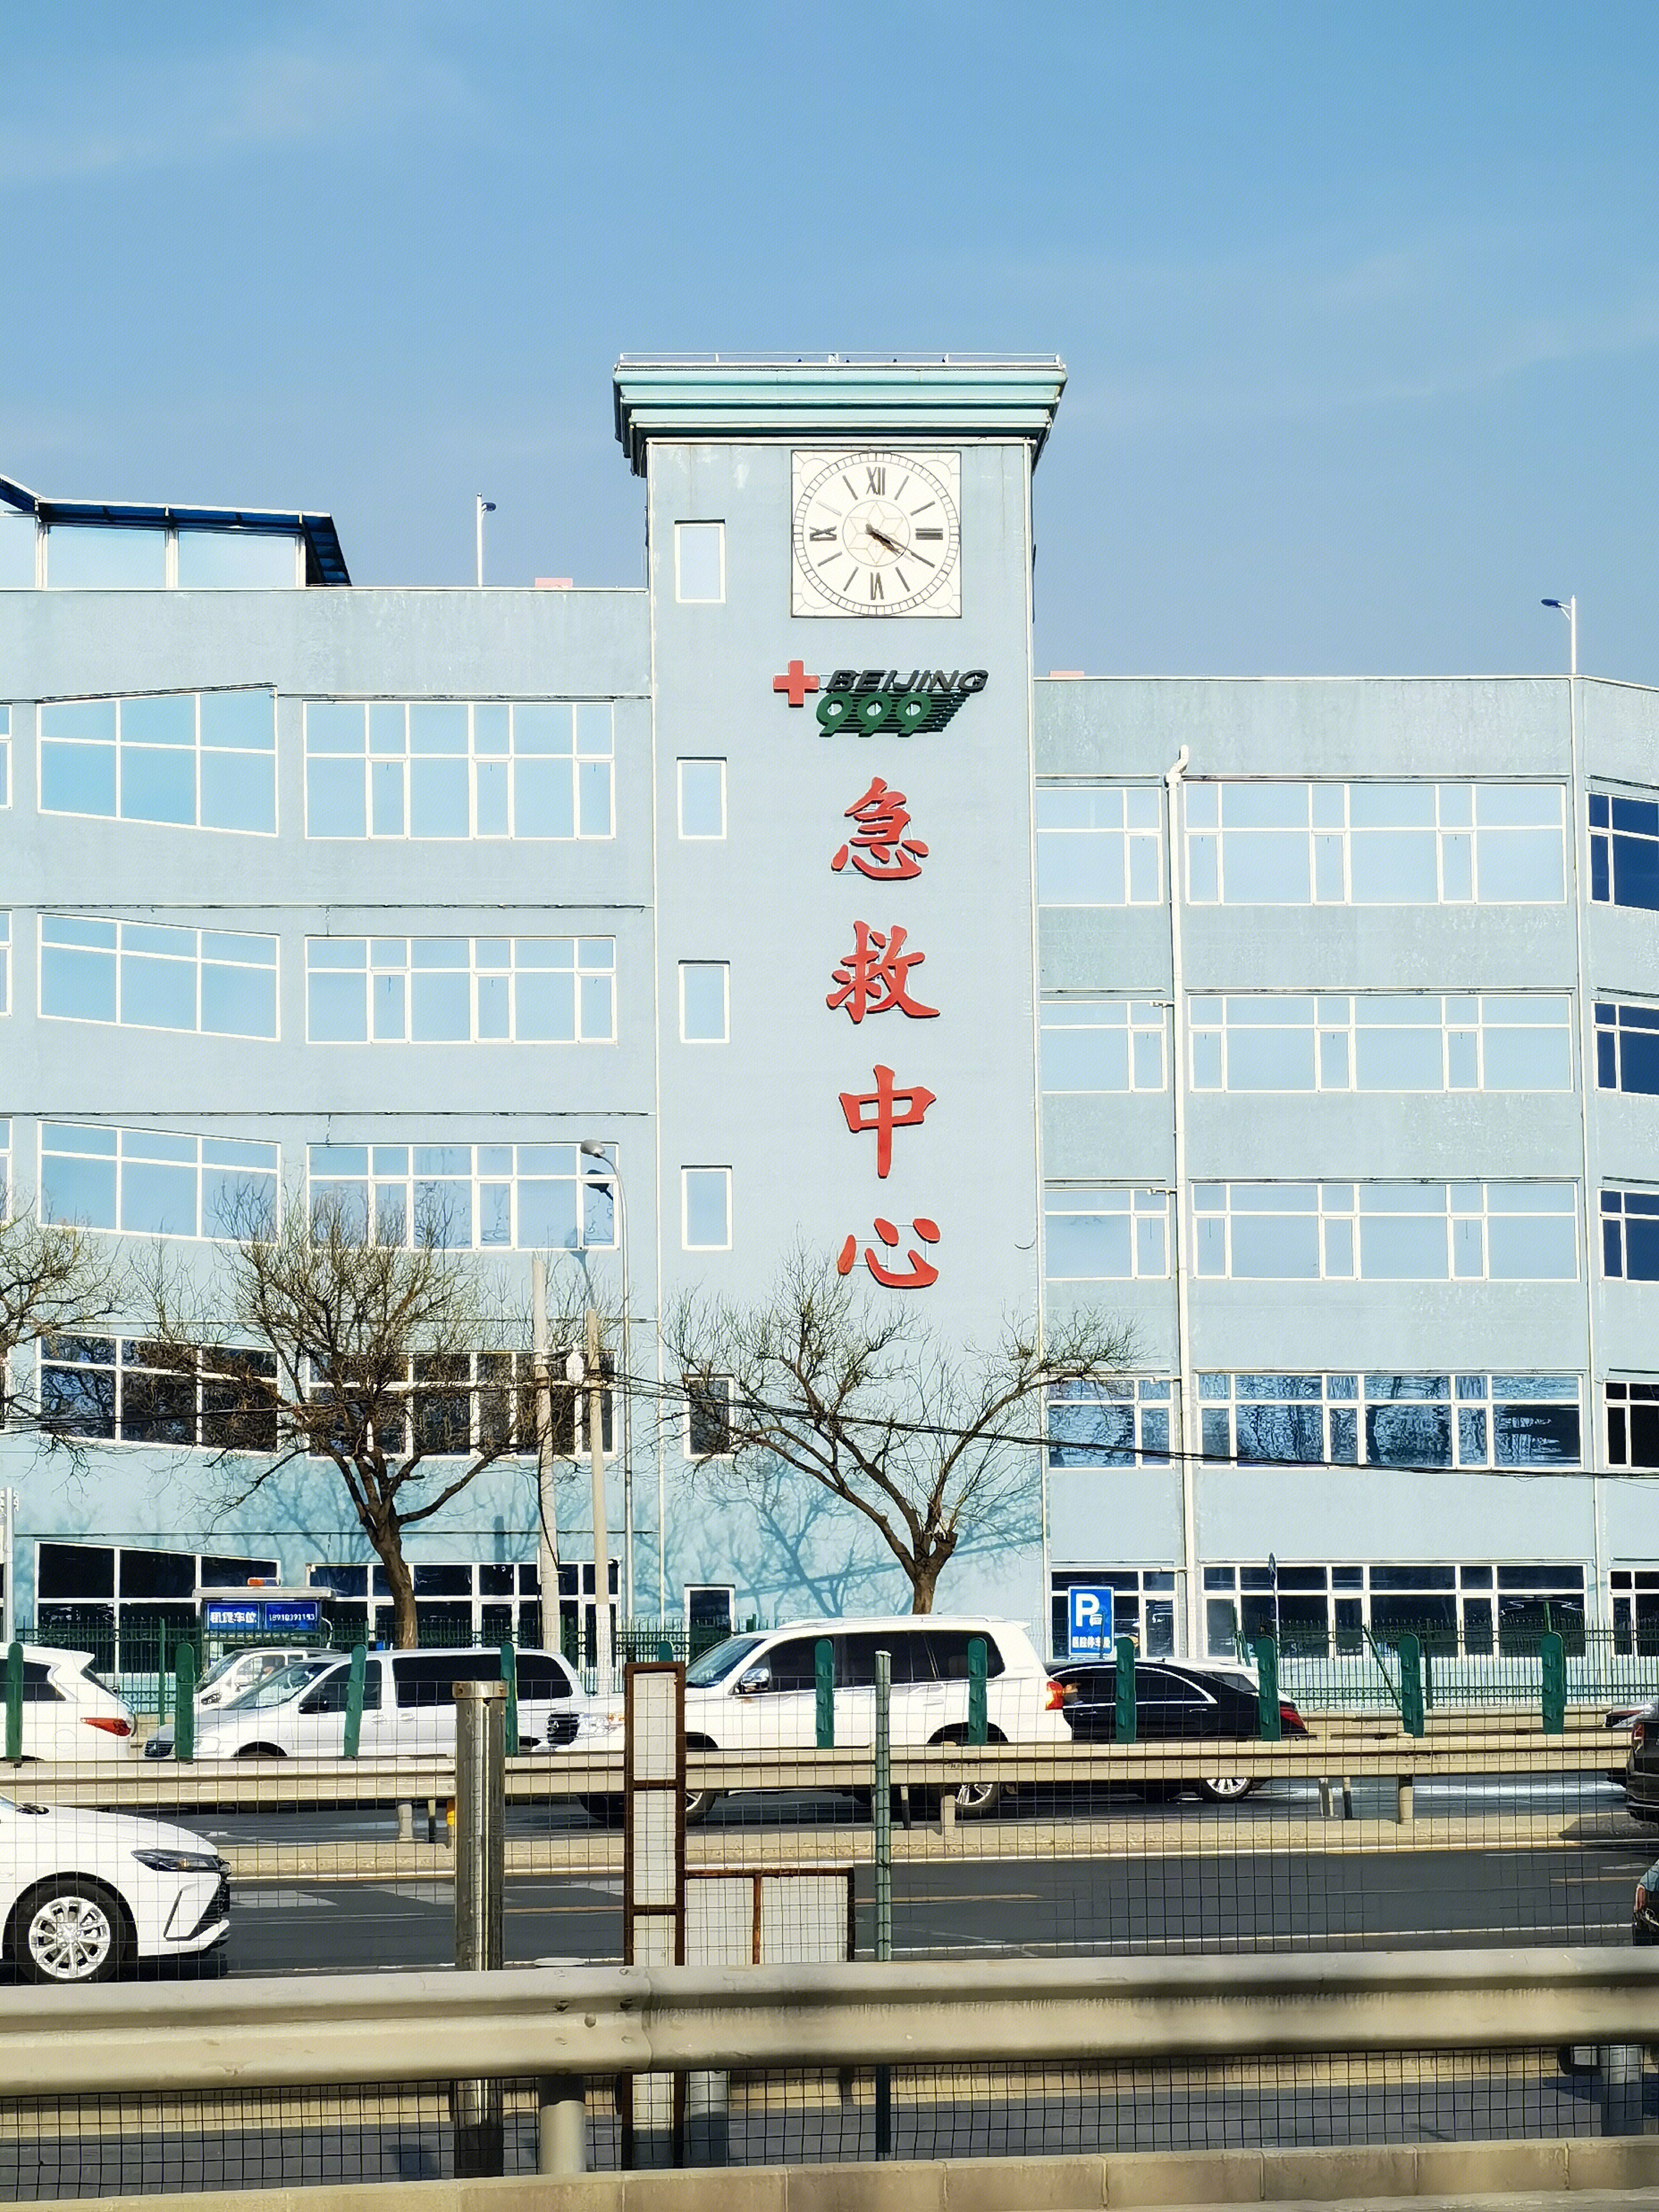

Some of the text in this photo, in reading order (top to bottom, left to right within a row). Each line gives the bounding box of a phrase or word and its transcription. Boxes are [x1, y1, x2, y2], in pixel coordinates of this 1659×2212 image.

[826, 669, 989, 693] BEIJING
[816, 692, 932, 738] 999
[827, 777, 940, 1287] 急救中心
[1076, 1593, 1100, 1627] P
